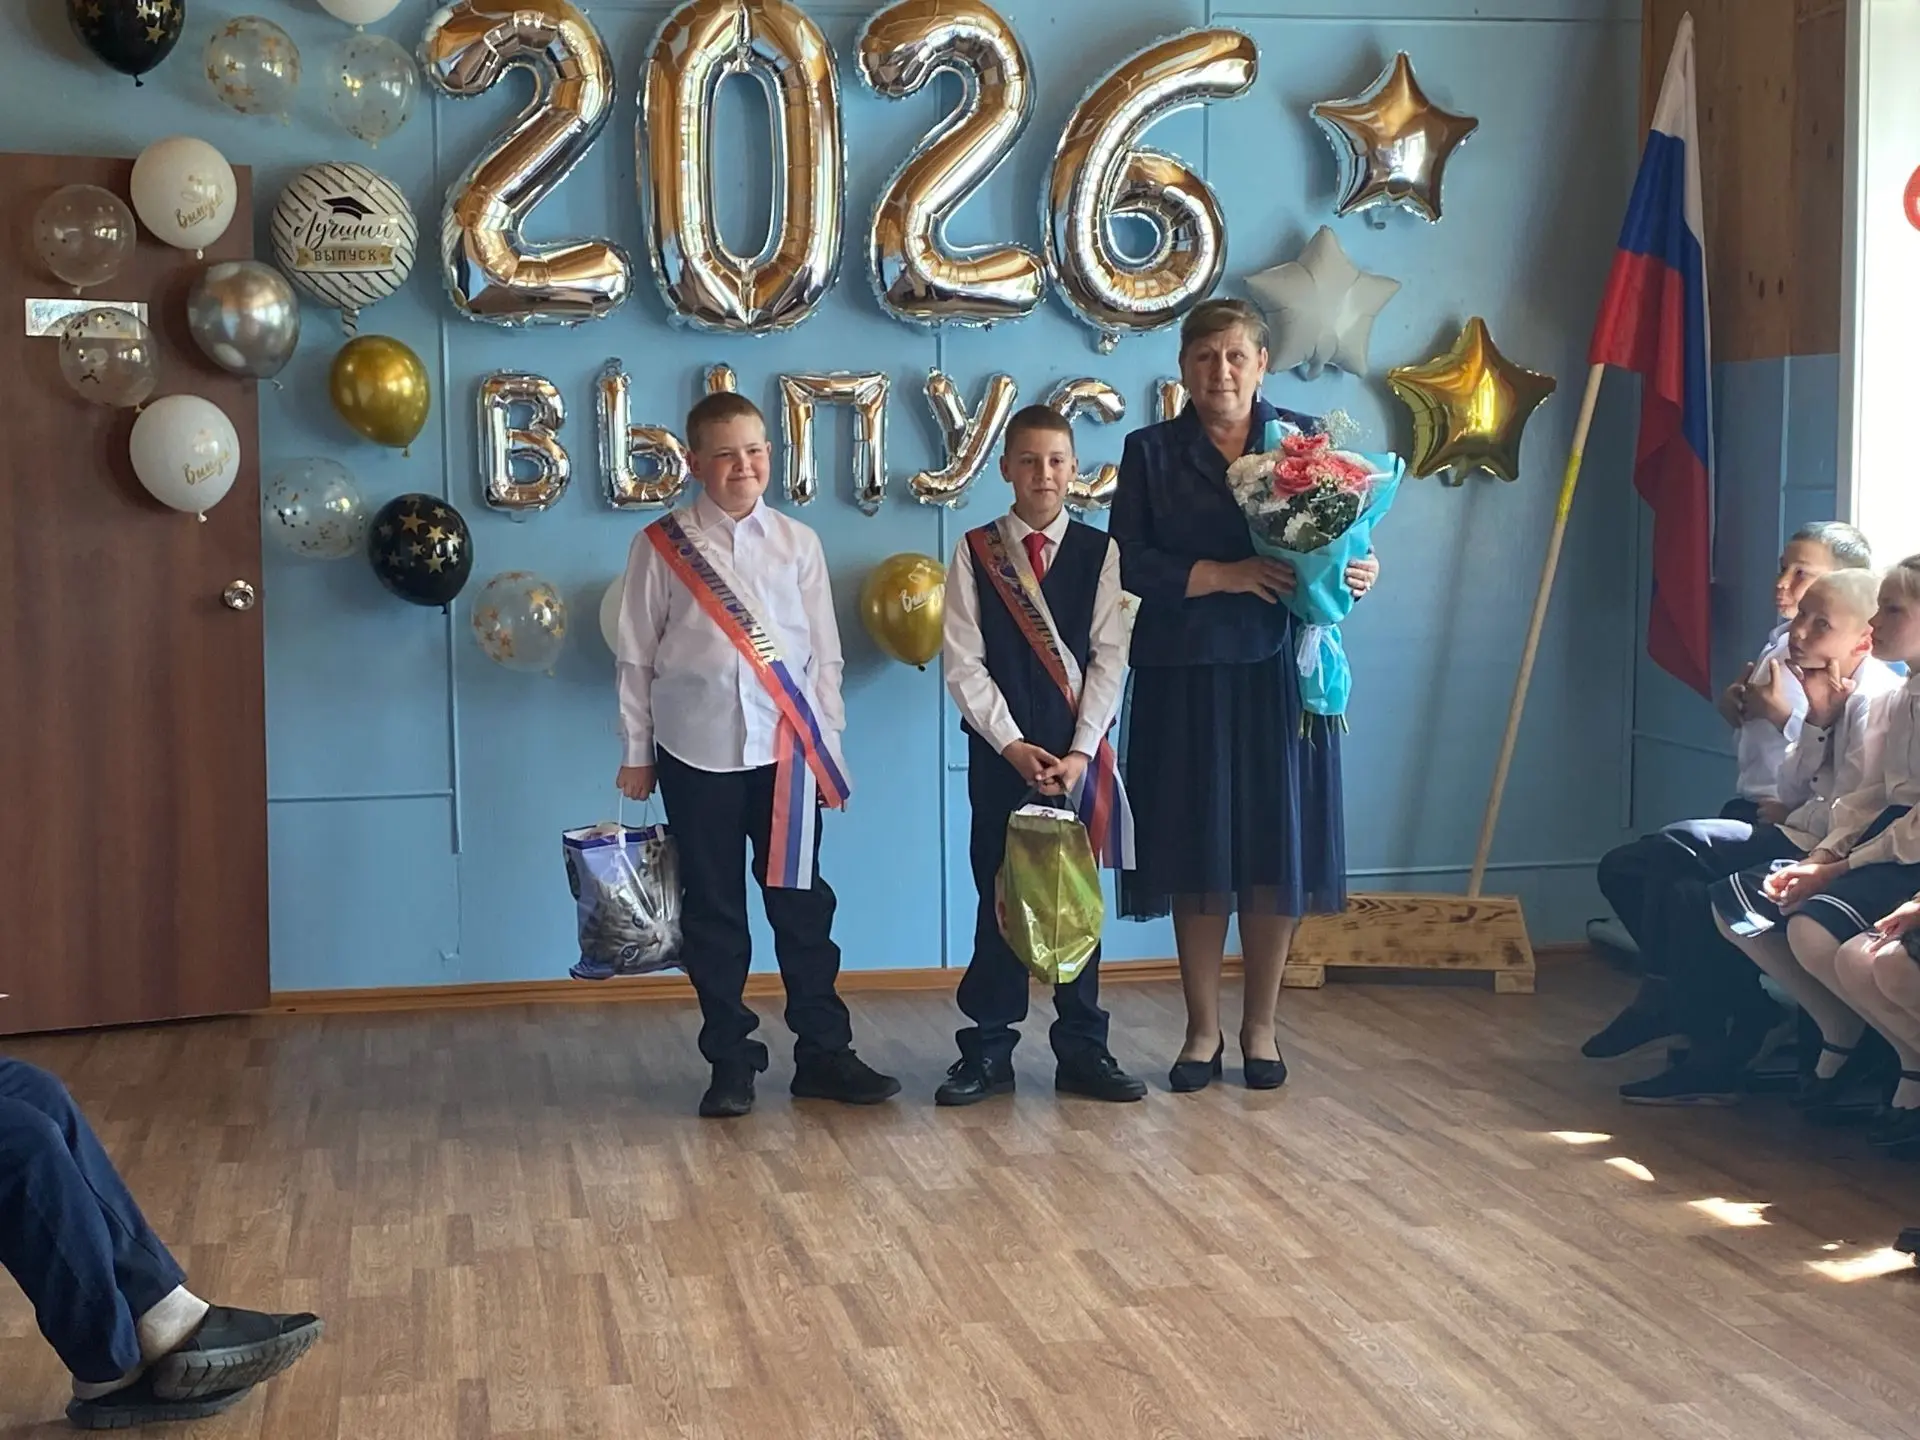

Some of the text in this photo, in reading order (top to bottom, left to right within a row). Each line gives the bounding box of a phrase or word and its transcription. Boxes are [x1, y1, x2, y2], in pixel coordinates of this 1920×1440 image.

[421, 0, 1259, 336] 2026
[314, 249, 377, 262] ВЫПУСК
[476, 362, 1190, 514] ВЫПУС
